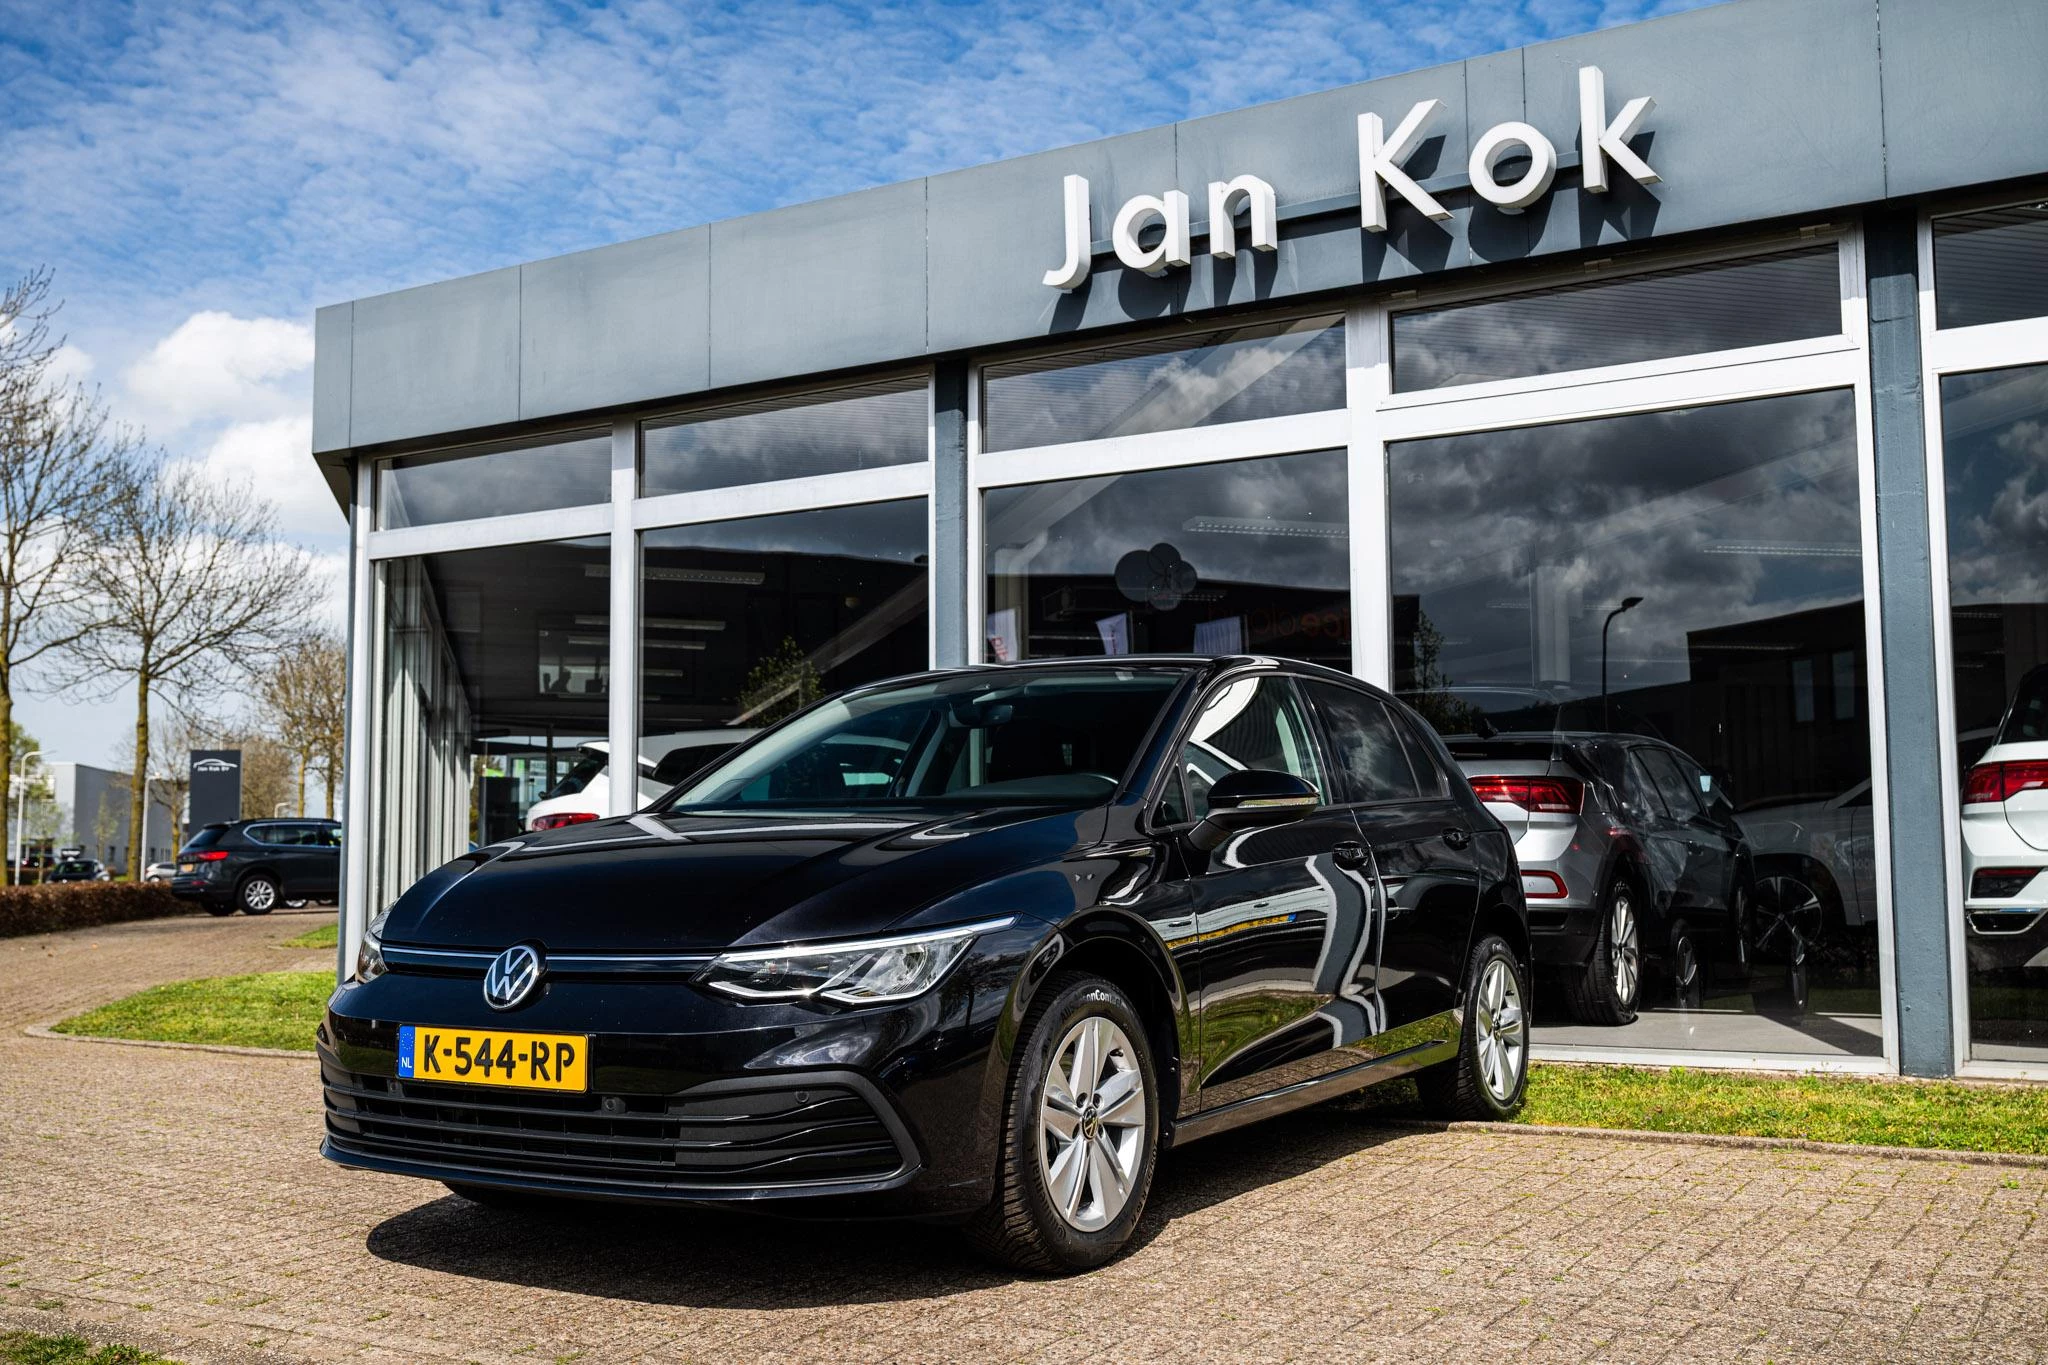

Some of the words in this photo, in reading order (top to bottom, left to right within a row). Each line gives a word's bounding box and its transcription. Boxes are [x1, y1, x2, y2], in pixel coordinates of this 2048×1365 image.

[1043, 174, 1278, 292] Jan
[1357, 65, 1665, 233] Kok
[401, 1056, 413, 1069] NL
[423, 1033, 576, 1083] K-544-RP
